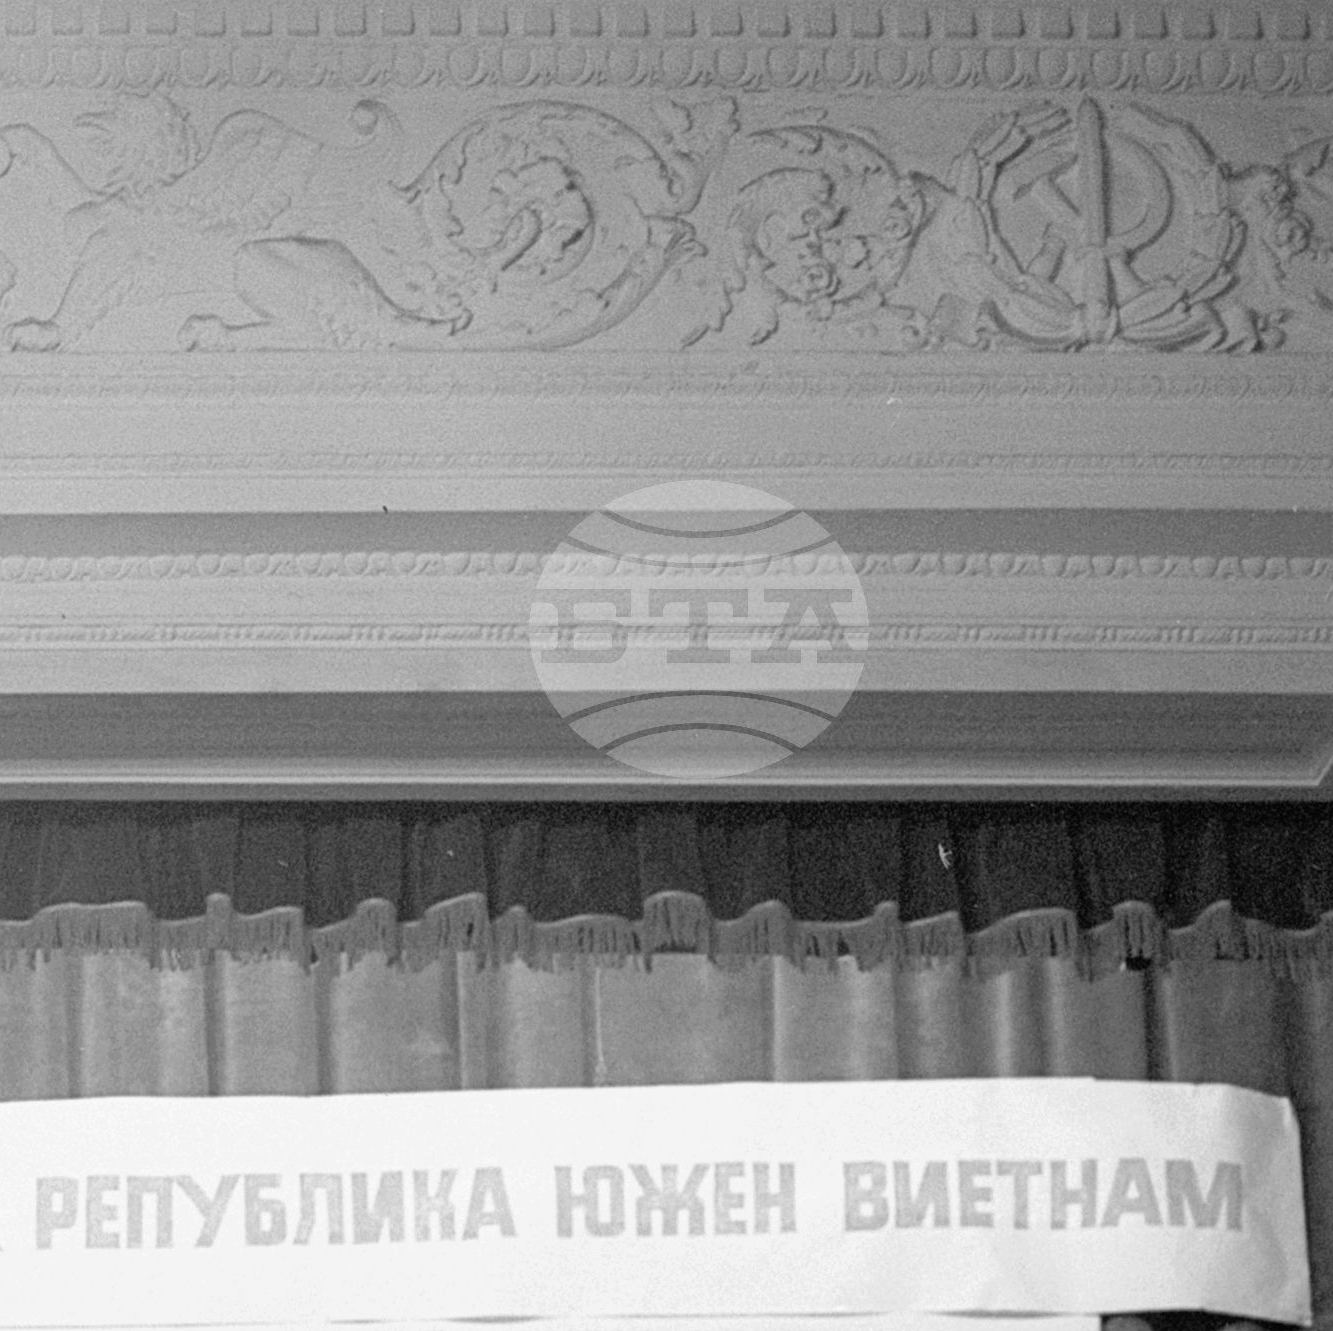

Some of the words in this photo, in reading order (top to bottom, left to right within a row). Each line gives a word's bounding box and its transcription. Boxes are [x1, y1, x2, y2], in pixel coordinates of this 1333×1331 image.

[35, 1166, 517, 1250] РЕПУБЛИКА
[554, 1161, 797, 1239] ЮЖЕН
[842, 1157, 1244, 1233] ВИЕТНАМ
